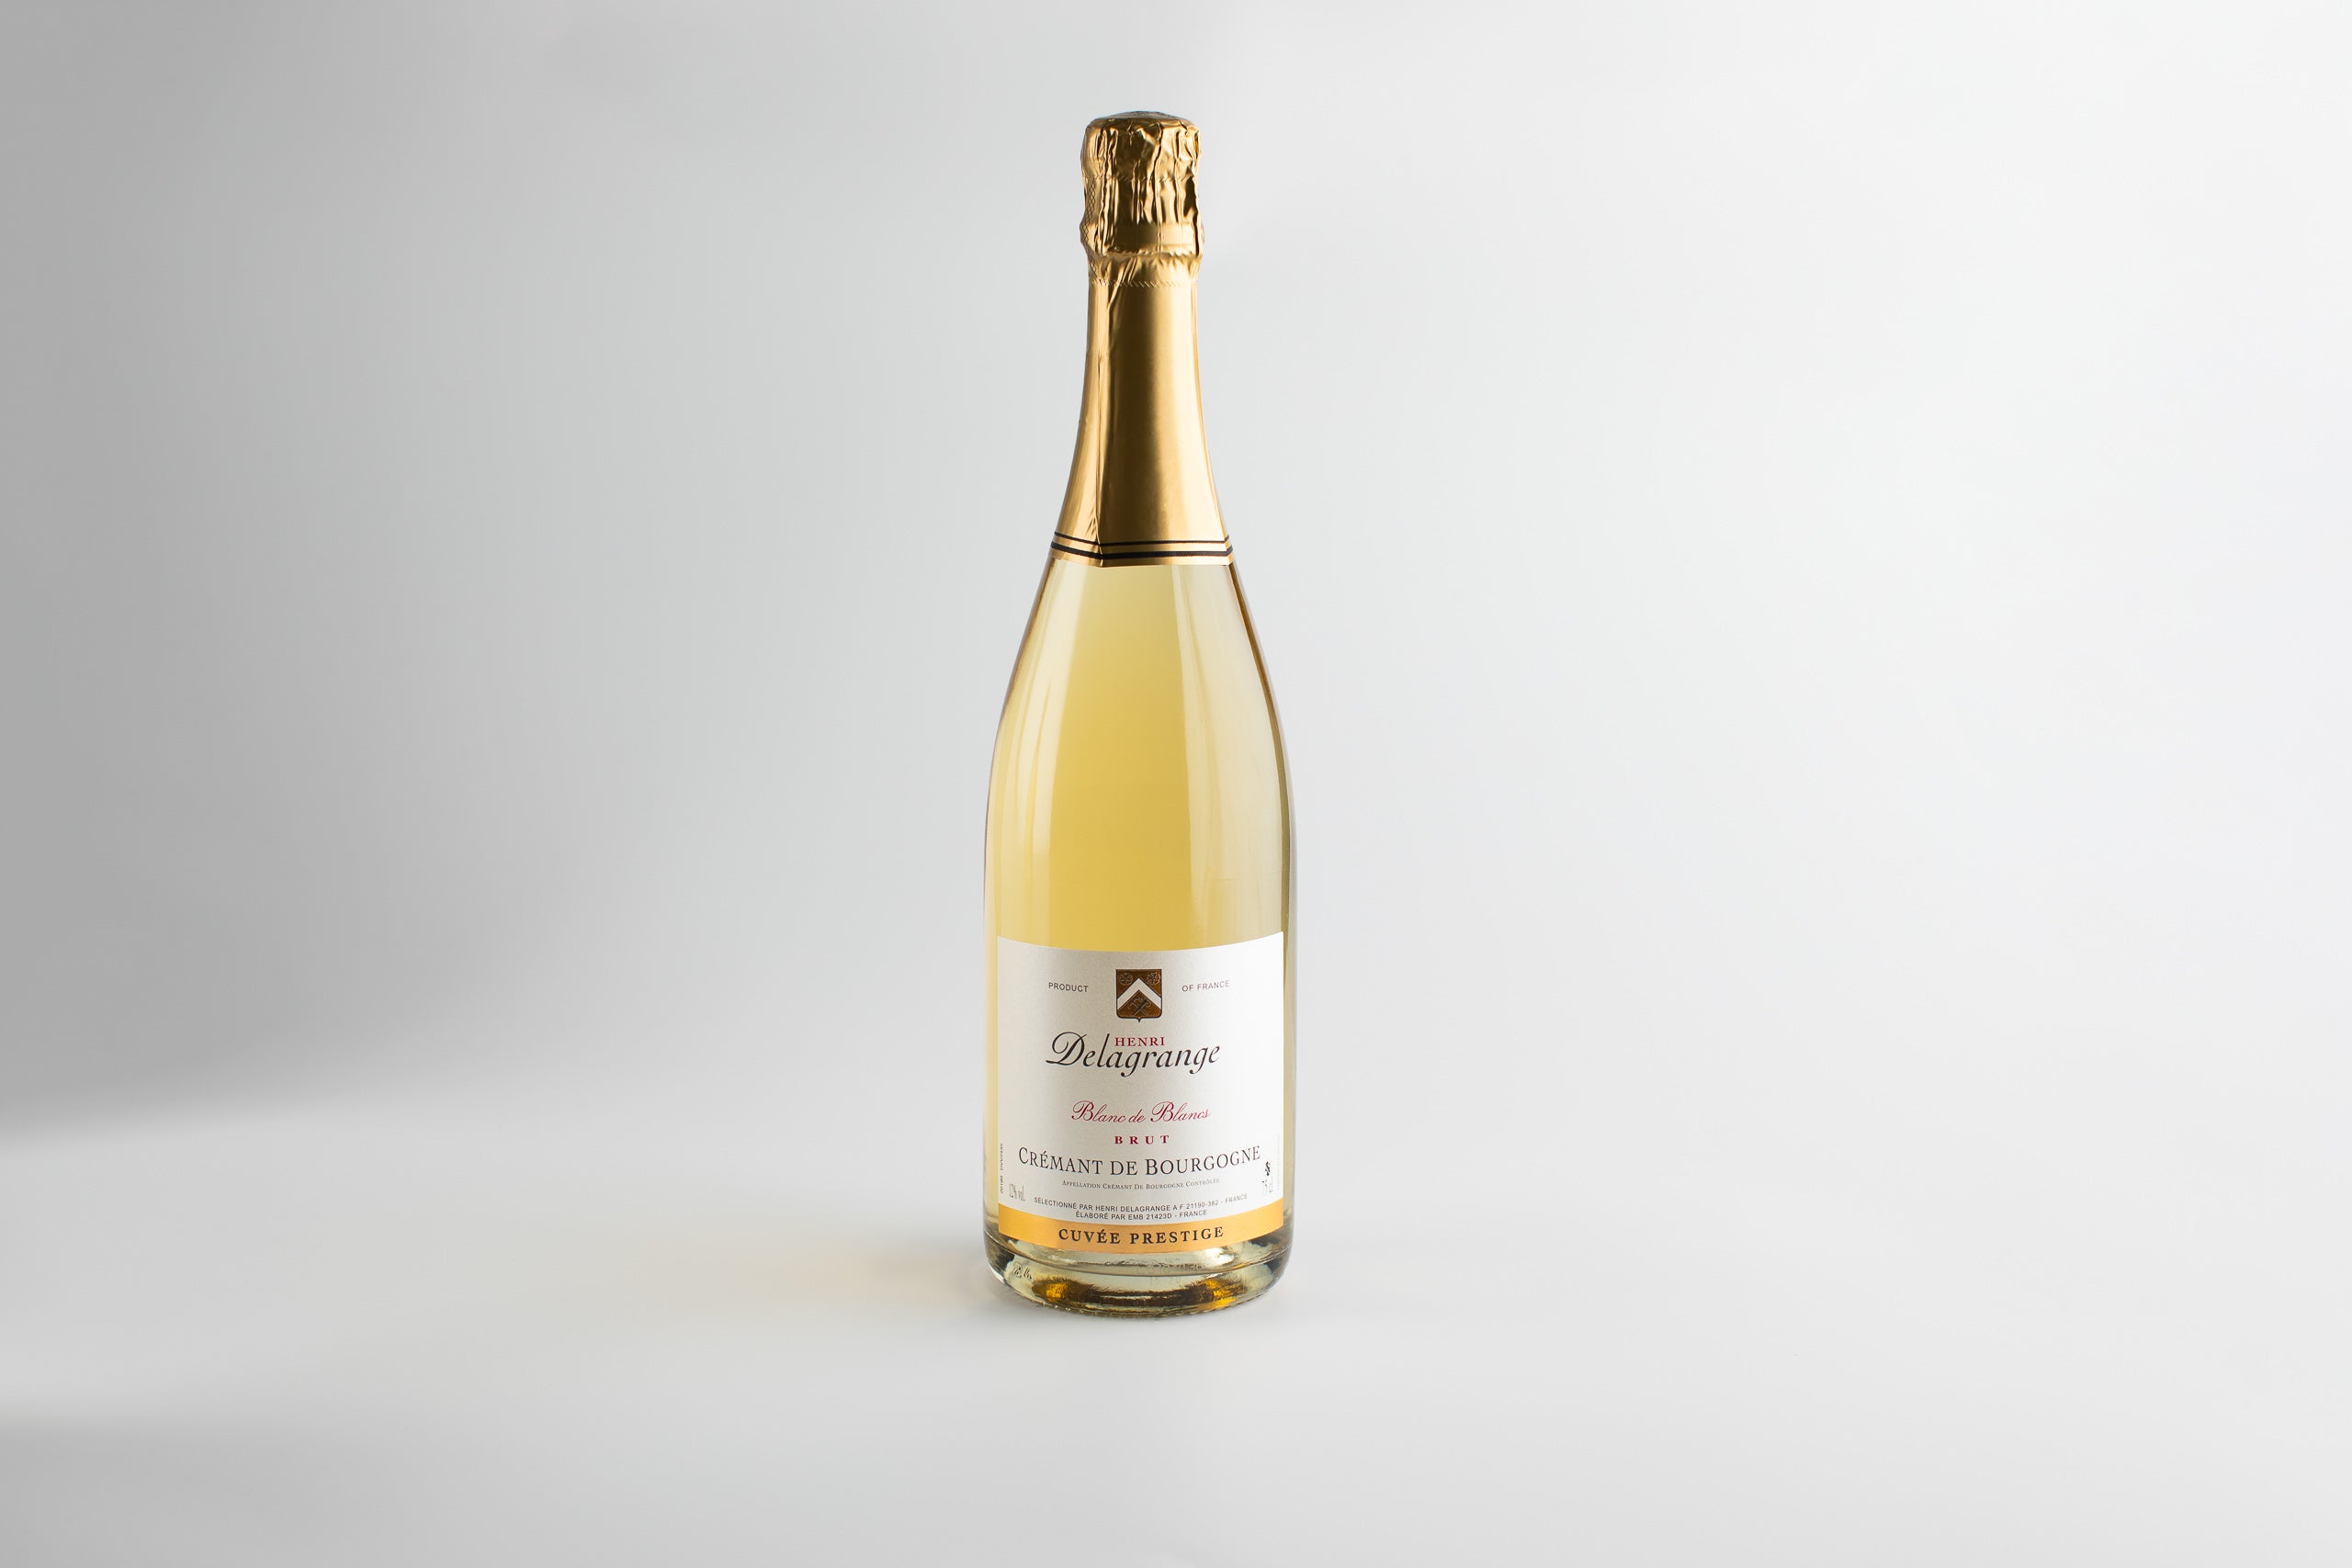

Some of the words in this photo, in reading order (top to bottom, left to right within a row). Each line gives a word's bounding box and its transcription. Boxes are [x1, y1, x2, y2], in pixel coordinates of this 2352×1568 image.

[1048, 982, 1089, 992] PRODUCT
[1182, 984, 1193, 992] OF
[1197, 979, 1230, 991] FRANCE
[1114, 1036, 1165, 1047] HENRI
[1046, 1032, 1220, 1077] Delagrange
[1071, 1100, 1126, 1122] Blanc
[1128, 1109, 1146, 1123] de
[1150, 1100, 1211, 1122] Blancs
[1114, 1134, 1170, 1145] BRUT
[1019, 1146, 1103, 1175] CRÉMANT
[1110, 1160, 1138, 1176] DE
[1145, 1145, 1261, 1176] BOURGOGNE
[1225, 1192, 1249, 1203] FRANCE
[1075, 1211, 1109, 1220] ÉLABORÉ
[1179, 1210, 1207, 1219] FRANCE
[1058, 1229, 1121, 1244] CUVÉE
[1130, 1226, 1224, 1244] PRESTIGE
